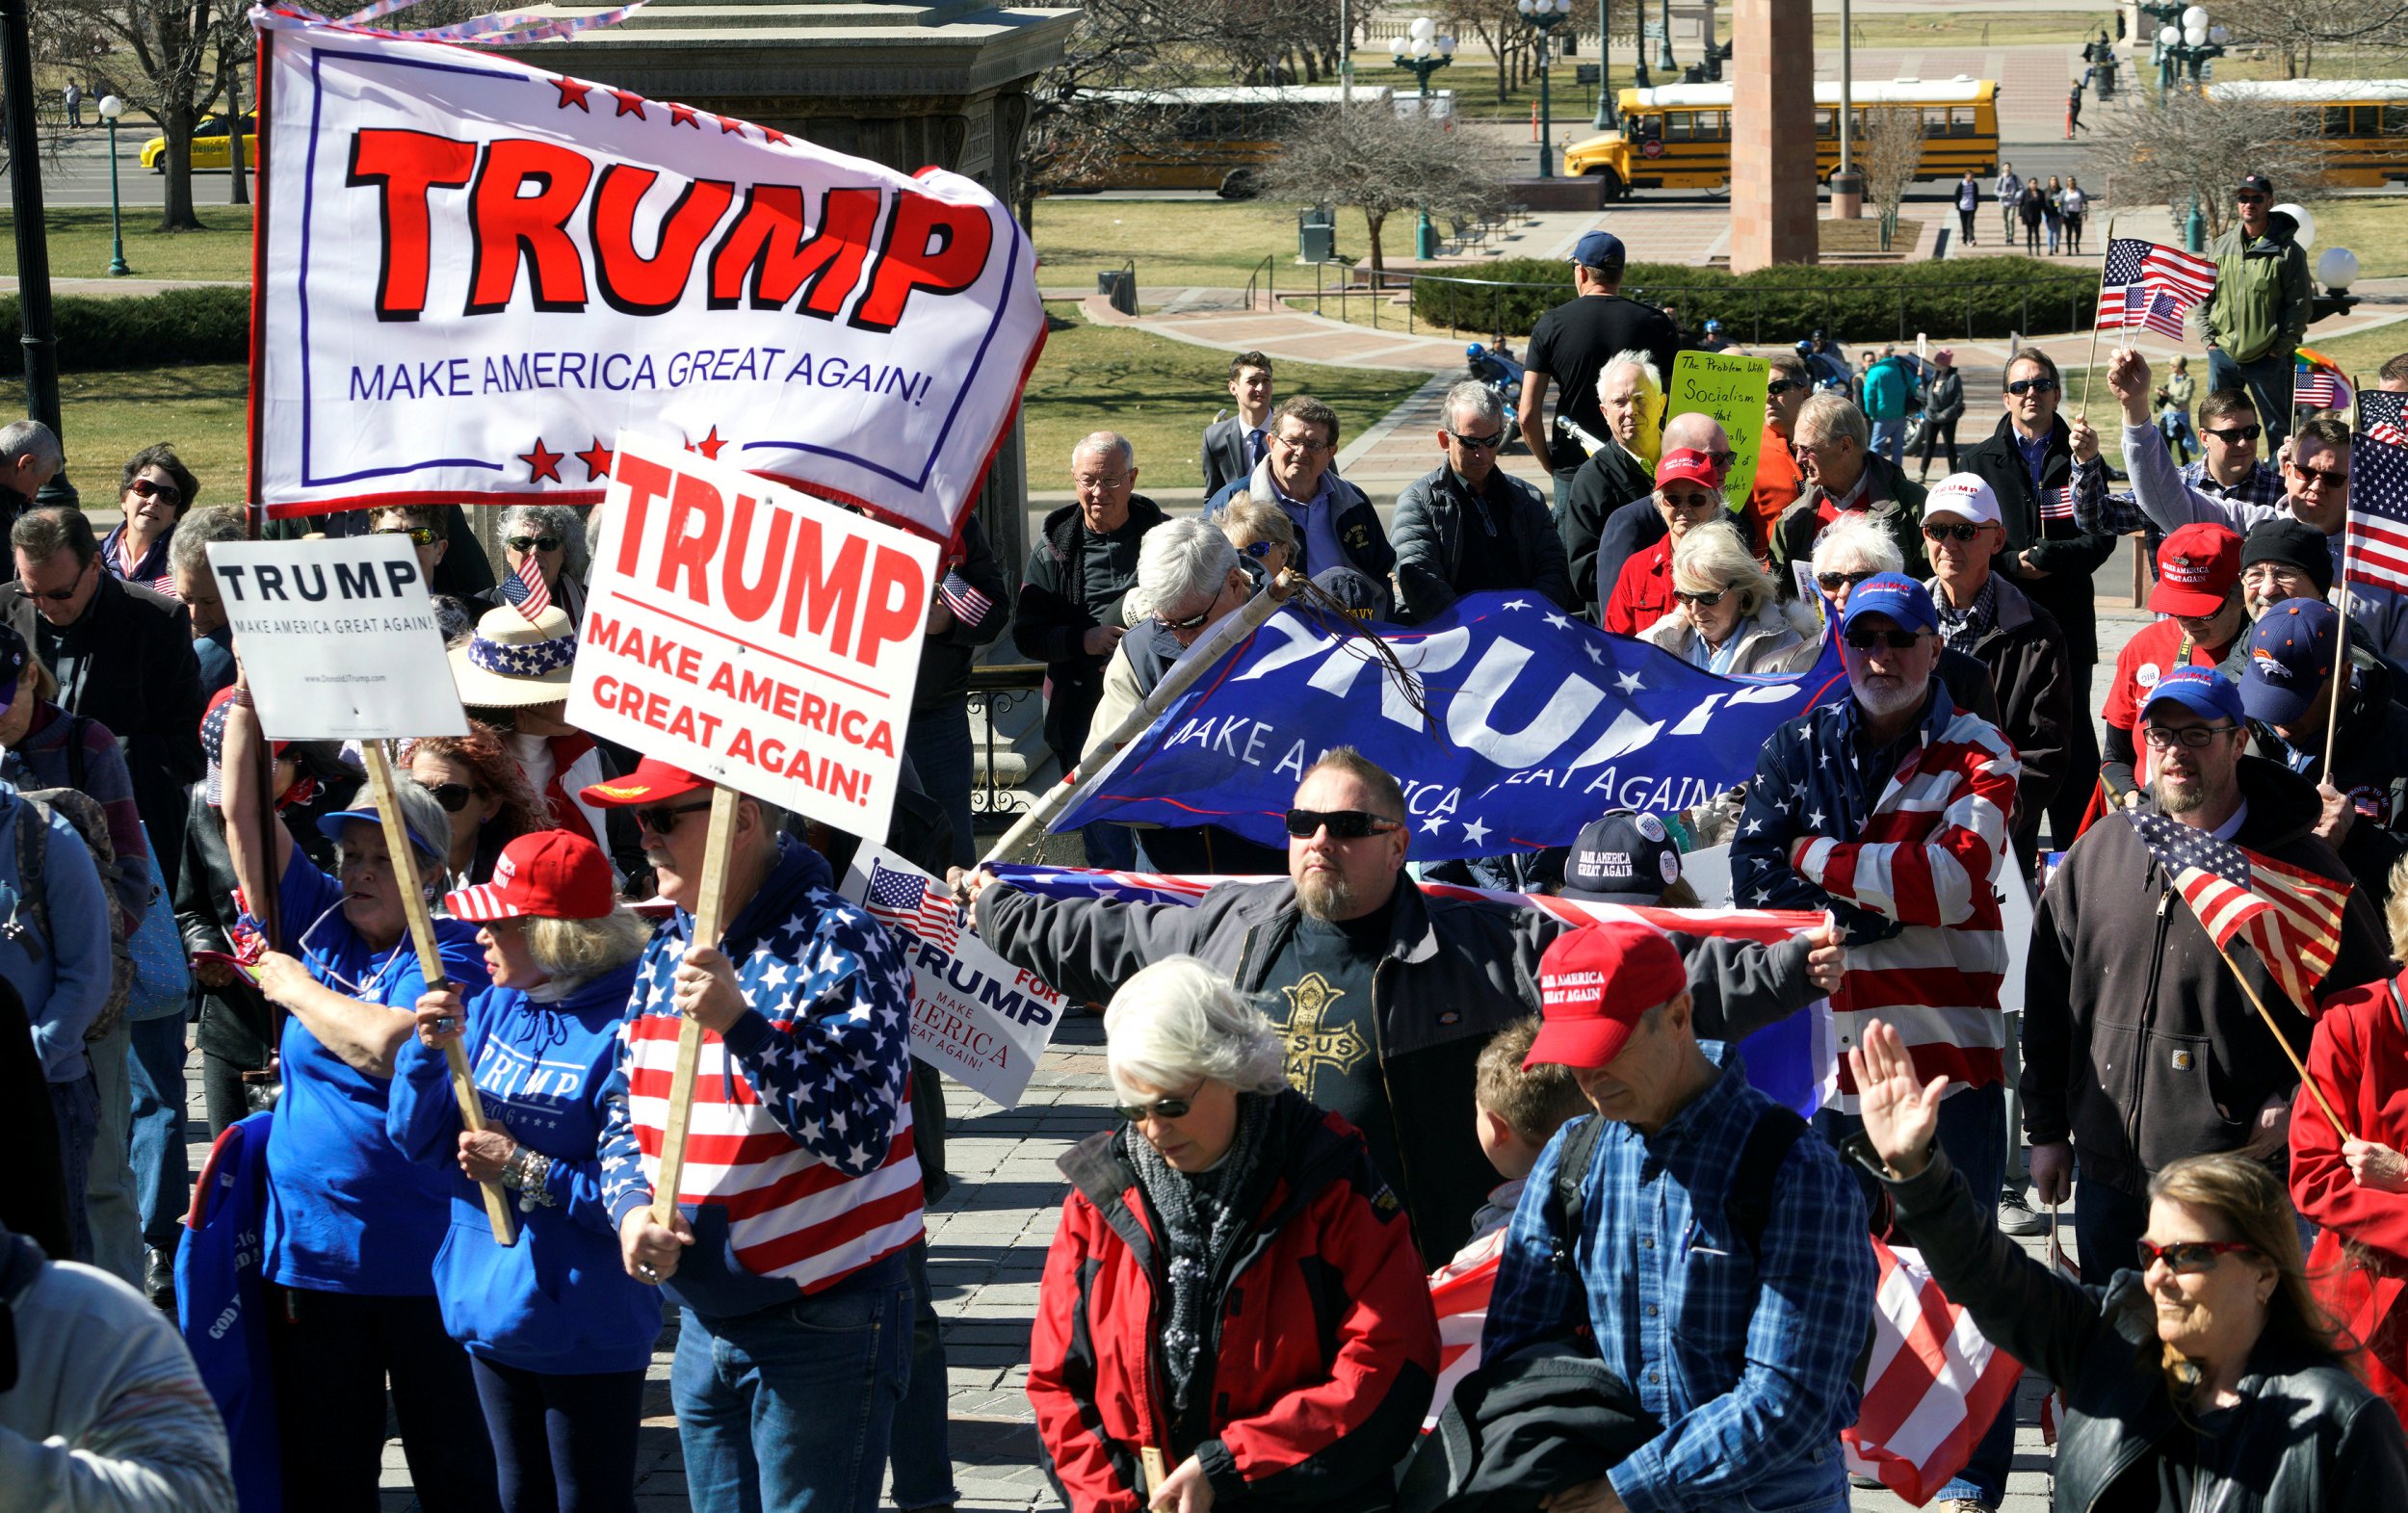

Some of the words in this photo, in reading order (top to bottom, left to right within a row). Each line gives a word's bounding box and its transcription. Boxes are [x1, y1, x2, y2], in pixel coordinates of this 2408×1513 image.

[193, 144, 223, 153] Yellow
[345, 127, 993, 333] TRUMP
[1683, 355, 1699, 370] The
[1706, 357, 1742, 374] Problem
[349, 357, 474, 401] MAKE
[483, 352, 657, 395] AMERICA
[667, 347, 785, 387] GREAT
[784, 352, 932, 406] AGAIN!
[1684, 378, 1755, 403] Socialism
[1713, 409, 1732, 422] that
[1741, 455, 1753, 467] of
[615, 451, 925, 668] TRUMP
[2176, 566, 2211, 575] AMERICA
[217, 561, 418, 602] TRUMP
[235, 619, 271, 635] MAKE
[274, 619, 331, 635] AMERICA
[334, 617, 379, 634] GREAT
[383, 615, 434, 633] AGAIN!
[1346, 608, 1374, 621] AVY
[587, 612, 703, 685] MAKE
[707, 661, 896, 760] AMERICA
[2141, 671, 2156, 683] BIG
[592, 674, 723, 749] GREAT
[725, 727, 873, 808] AGAIN!
[2345, 785, 2369, 799] PROUD
[2372, 787, 2382, 796] TO
[1641, 818, 1655, 832] BIG
[1596, 851, 1632, 865] AMERICA
[1663, 856, 1676, 868] BIG
[1578, 864, 1601, 877] GREAT
[1602, 864, 1634, 877] AGAIN
[894, 923, 1053, 1027] TRUMP
[1557, 971, 1606, 987] AMERICA
[1014, 967, 1061, 1006] FOR
[1566, 987, 1602, 1003] AGAIN
[935, 991, 974, 1020] MAKE
[912, 998, 1008, 1070] MERICA
[935, 1036, 983, 1073] AGAIN!
[1293, 1034, 1352, 1056] SUS
[484, 1101, 514, 1125] 206
[208, 1307, 239, 1340] GOD
